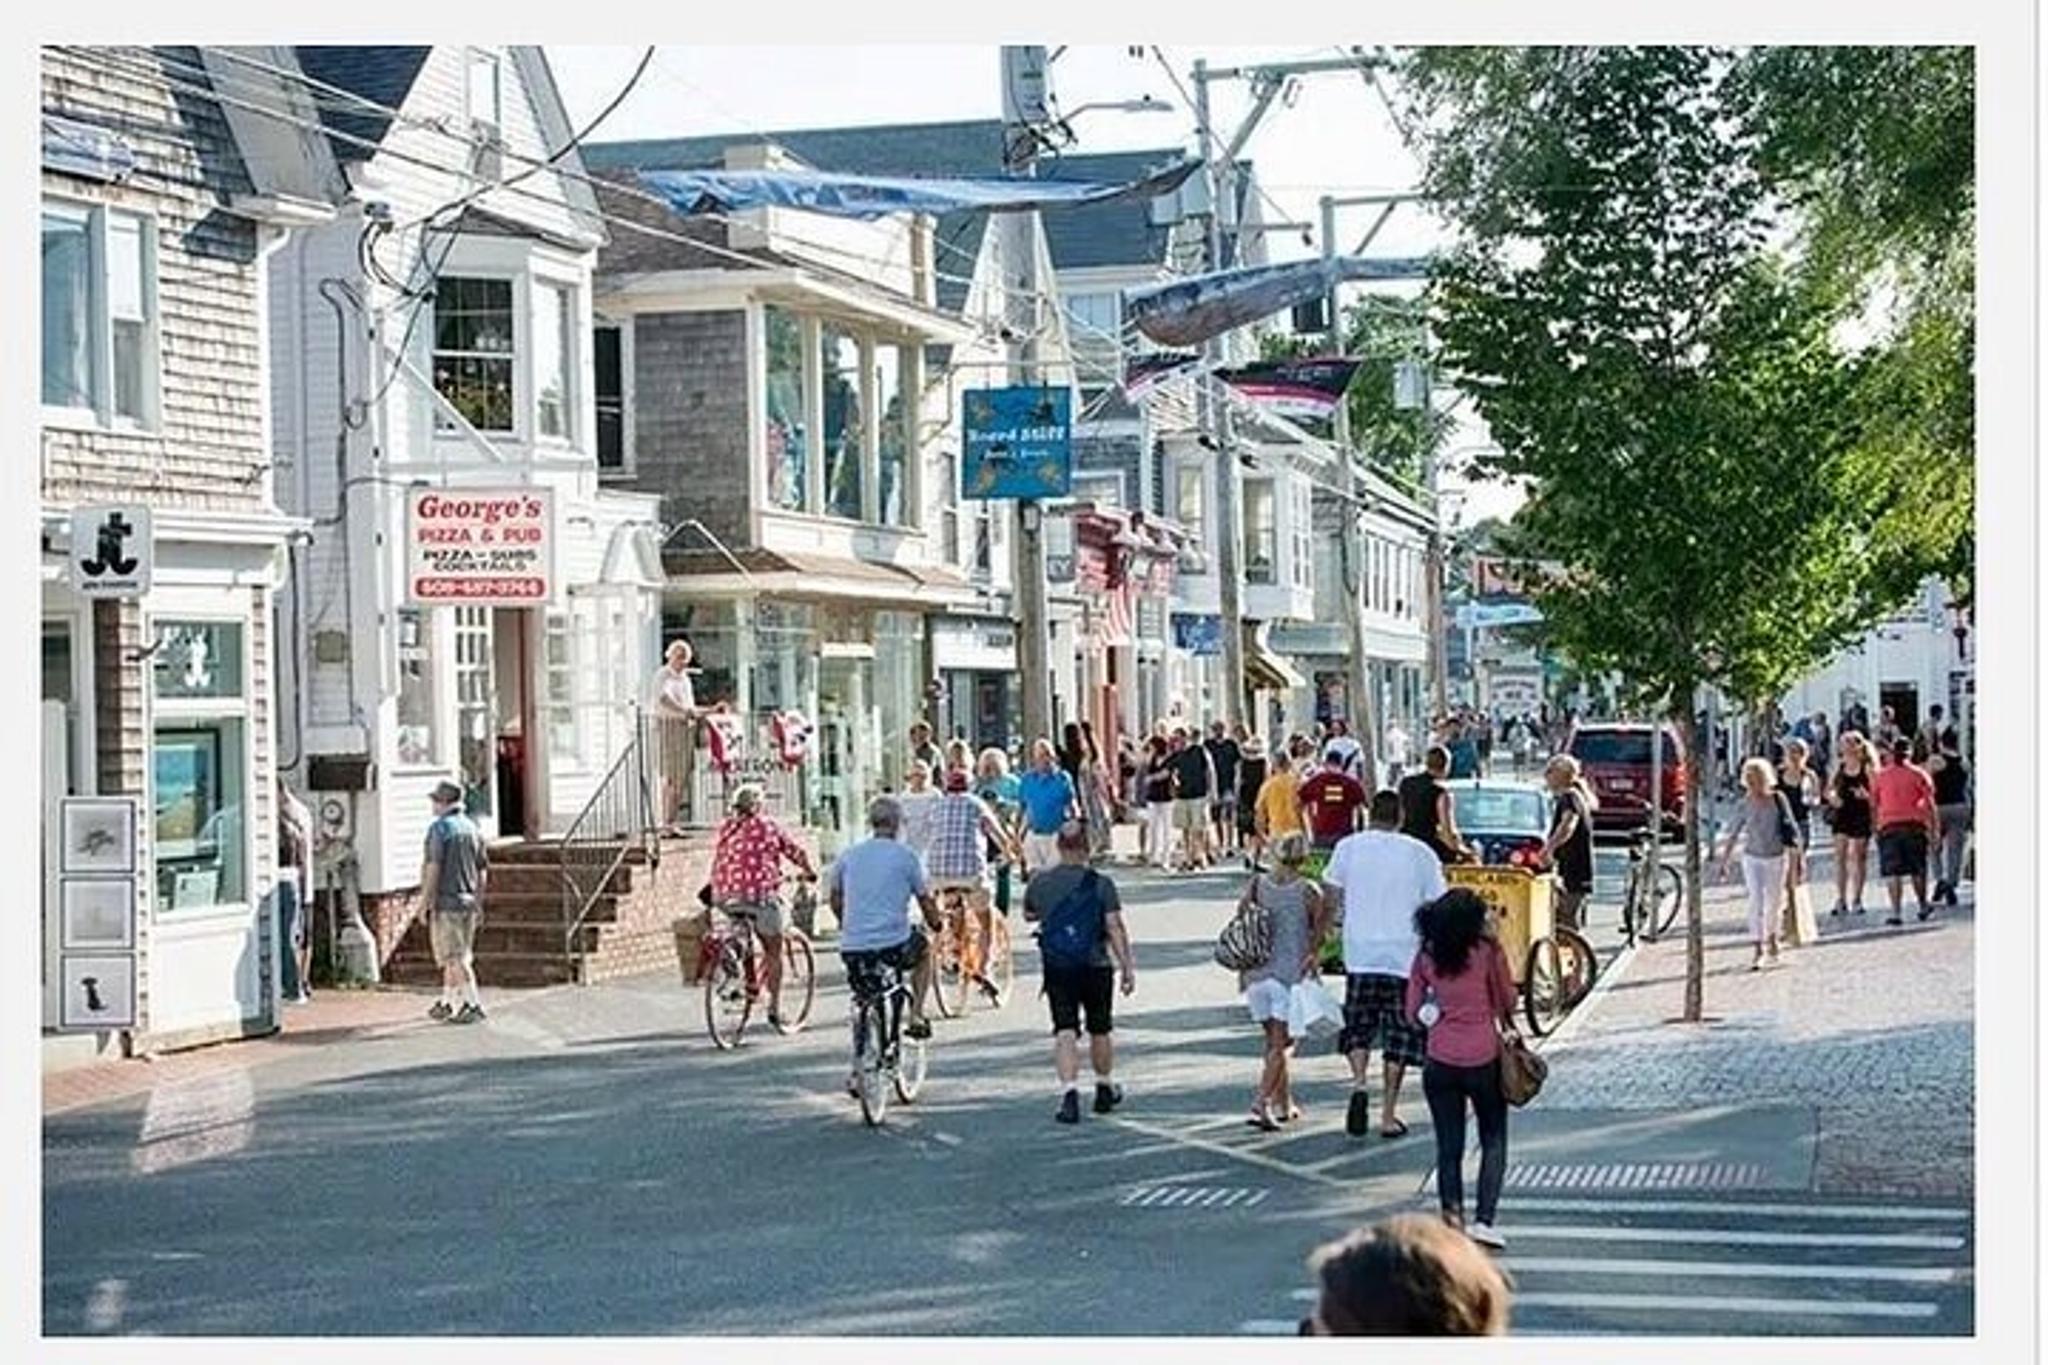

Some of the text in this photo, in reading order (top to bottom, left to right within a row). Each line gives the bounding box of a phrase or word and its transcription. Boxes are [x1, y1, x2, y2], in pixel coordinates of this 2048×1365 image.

[418, 495, 542, 524] George's
[418, 528, 542, 542] PIZZA & PUB
[423, 550, 473, 560] PIZZA
[490, 550, 537, 560] SUBS
[433, 561, 527, 572] COCKTAILS
